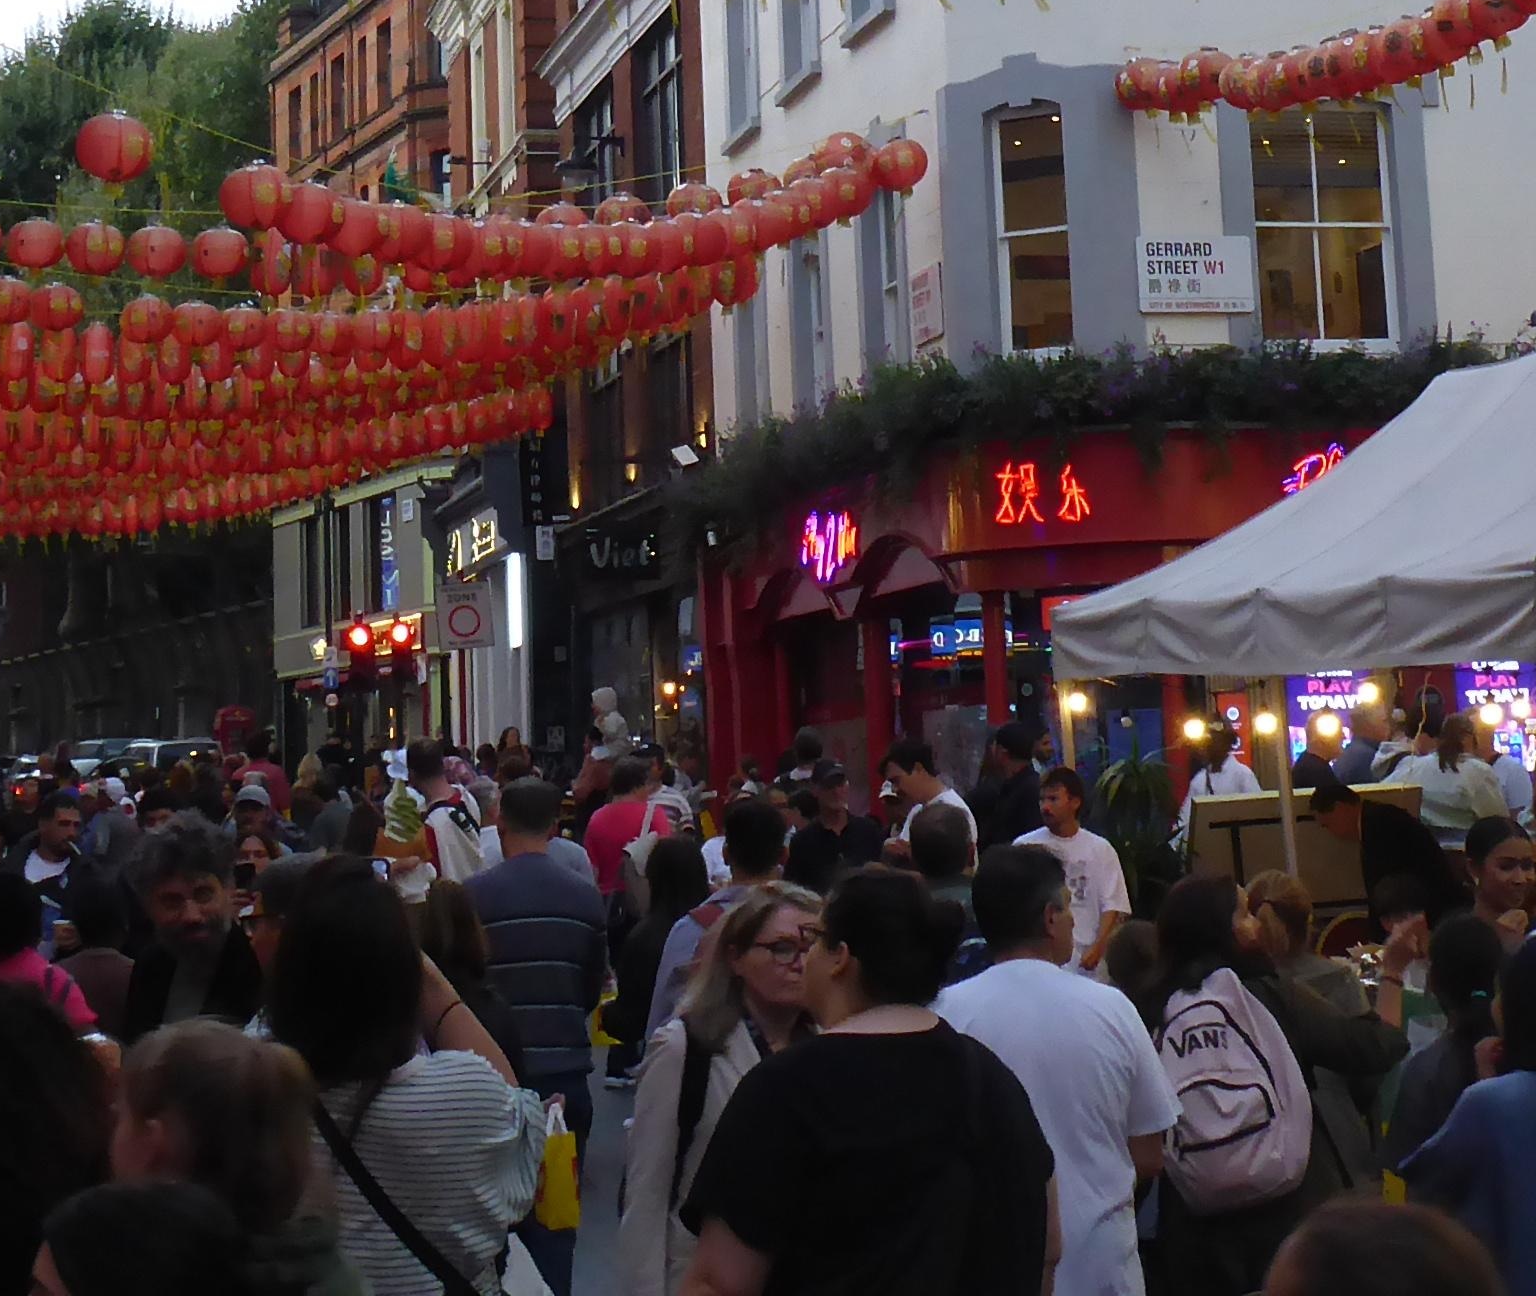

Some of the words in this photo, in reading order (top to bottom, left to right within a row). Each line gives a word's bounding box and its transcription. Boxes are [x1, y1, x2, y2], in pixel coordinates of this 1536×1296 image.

[1146, 242, 1212, 257] GERRARD
[1147, 260, 1198, 275] STREET
[1203, 260, 1225, 275] W1
[589, 535, 650, 570] Viet
[1307, 680, 1353, 694] PLAY
[1475, 675, 1518, 688] PLAY
